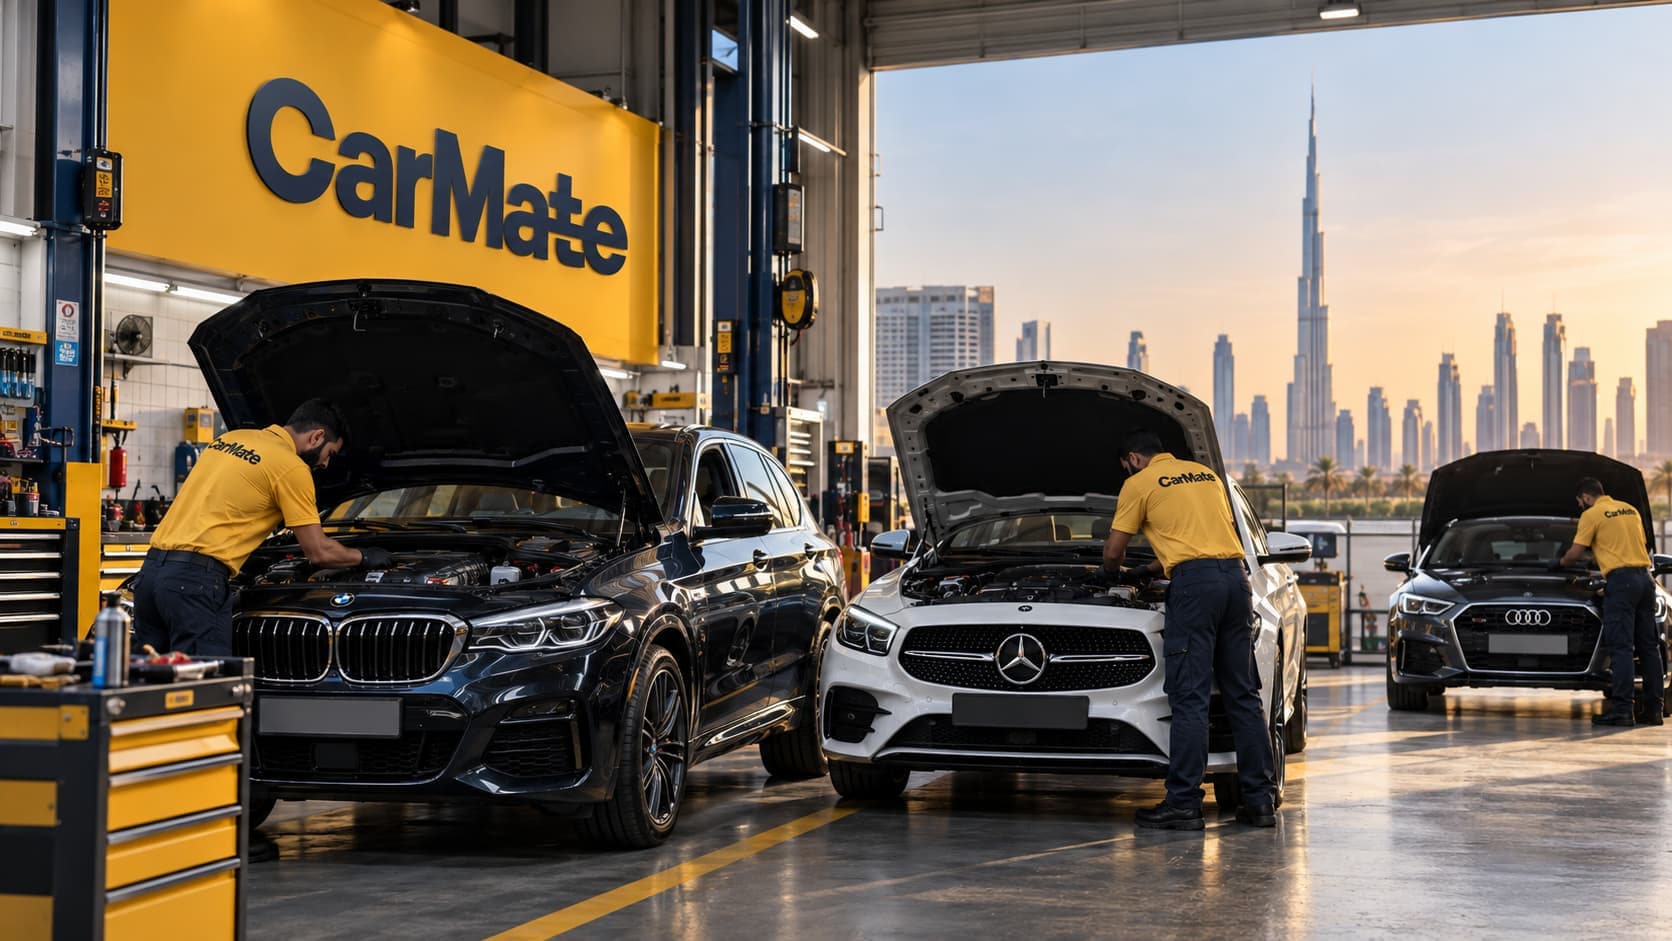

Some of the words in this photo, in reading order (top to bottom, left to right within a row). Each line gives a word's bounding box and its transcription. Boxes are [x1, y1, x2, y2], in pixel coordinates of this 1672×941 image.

[247, 78, 628, 275] CarMate
[208, 438, 261, 464] CarMate
[1158, 472, 1216, 488] CarMate
